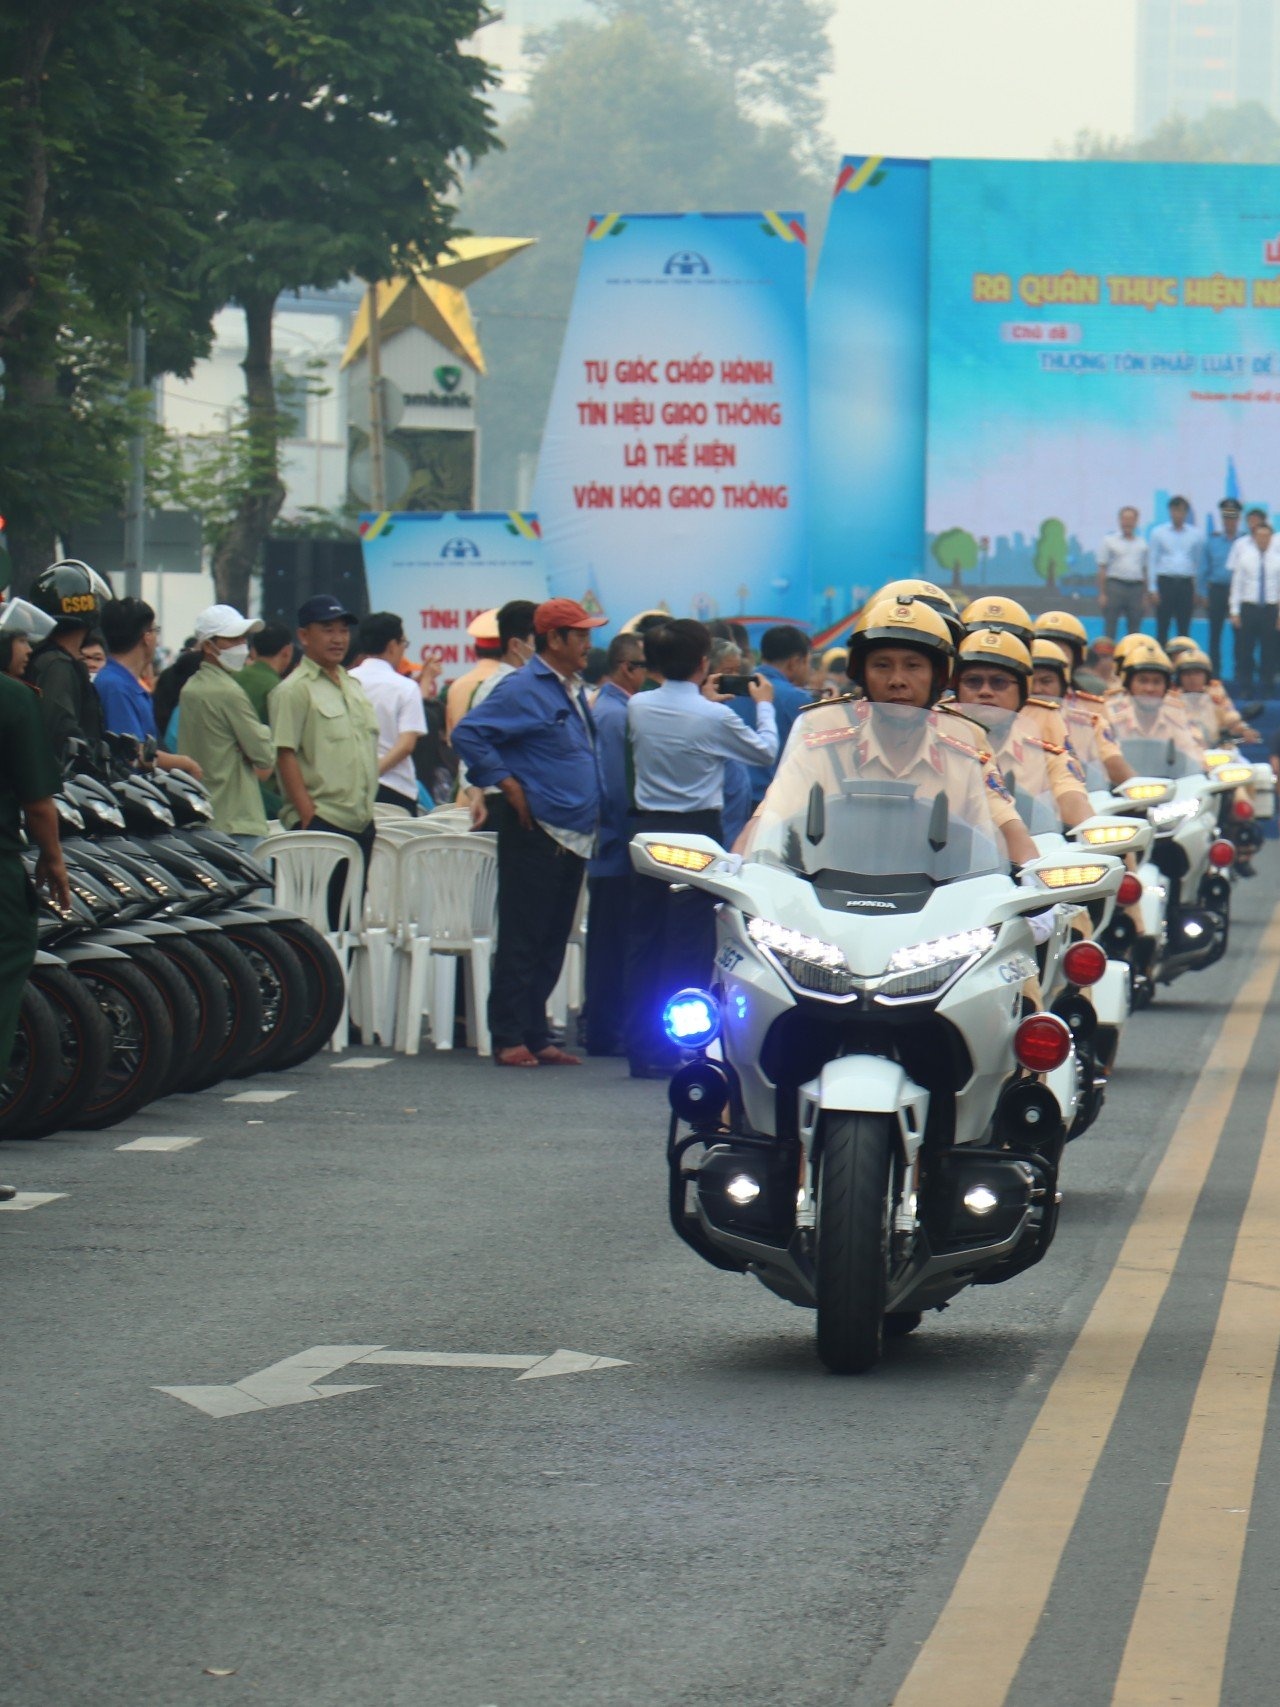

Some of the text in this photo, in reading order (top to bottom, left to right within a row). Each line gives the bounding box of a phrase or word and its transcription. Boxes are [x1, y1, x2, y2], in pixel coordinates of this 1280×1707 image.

[973, 273, 1011, 302] RA
[1019, 269, 1099, 307] QUÂN
[1106, 276, 1179, 312] THỰC
[1184, 272, 1246, 313] HIỆN
[584, 352, 774, 389] TỰ GIÁC CHẤP HÀNH
[577, 397, 782, 431] TÍN HIỆU GIAO THÔNG
[624, 433, 736, 473] LÀ THỂ HIỆN
[573, 480, 788, 508] VĂN HÓA GIAO THÔNG
[420, 604, 459, 629] TÍNH
[421, 645, 458, 664] CON
[847, 900, 898, 909] HONDA
